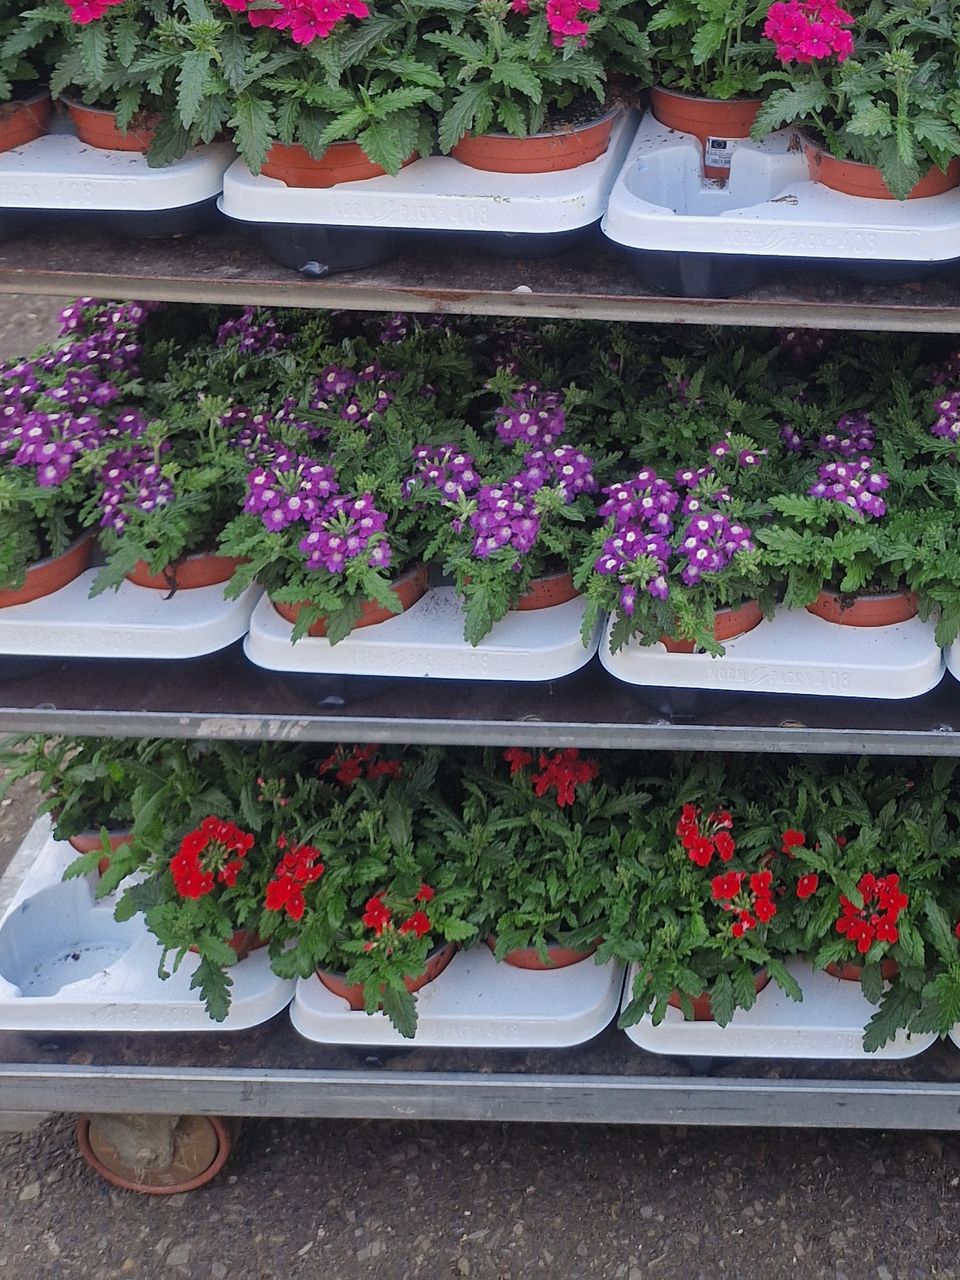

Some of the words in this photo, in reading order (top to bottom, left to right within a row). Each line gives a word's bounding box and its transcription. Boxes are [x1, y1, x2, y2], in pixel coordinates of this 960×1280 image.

[451, 202, 489, 225] 408
[838, 231, 877, 253] 408
[816, 670, 850, 689] 408
